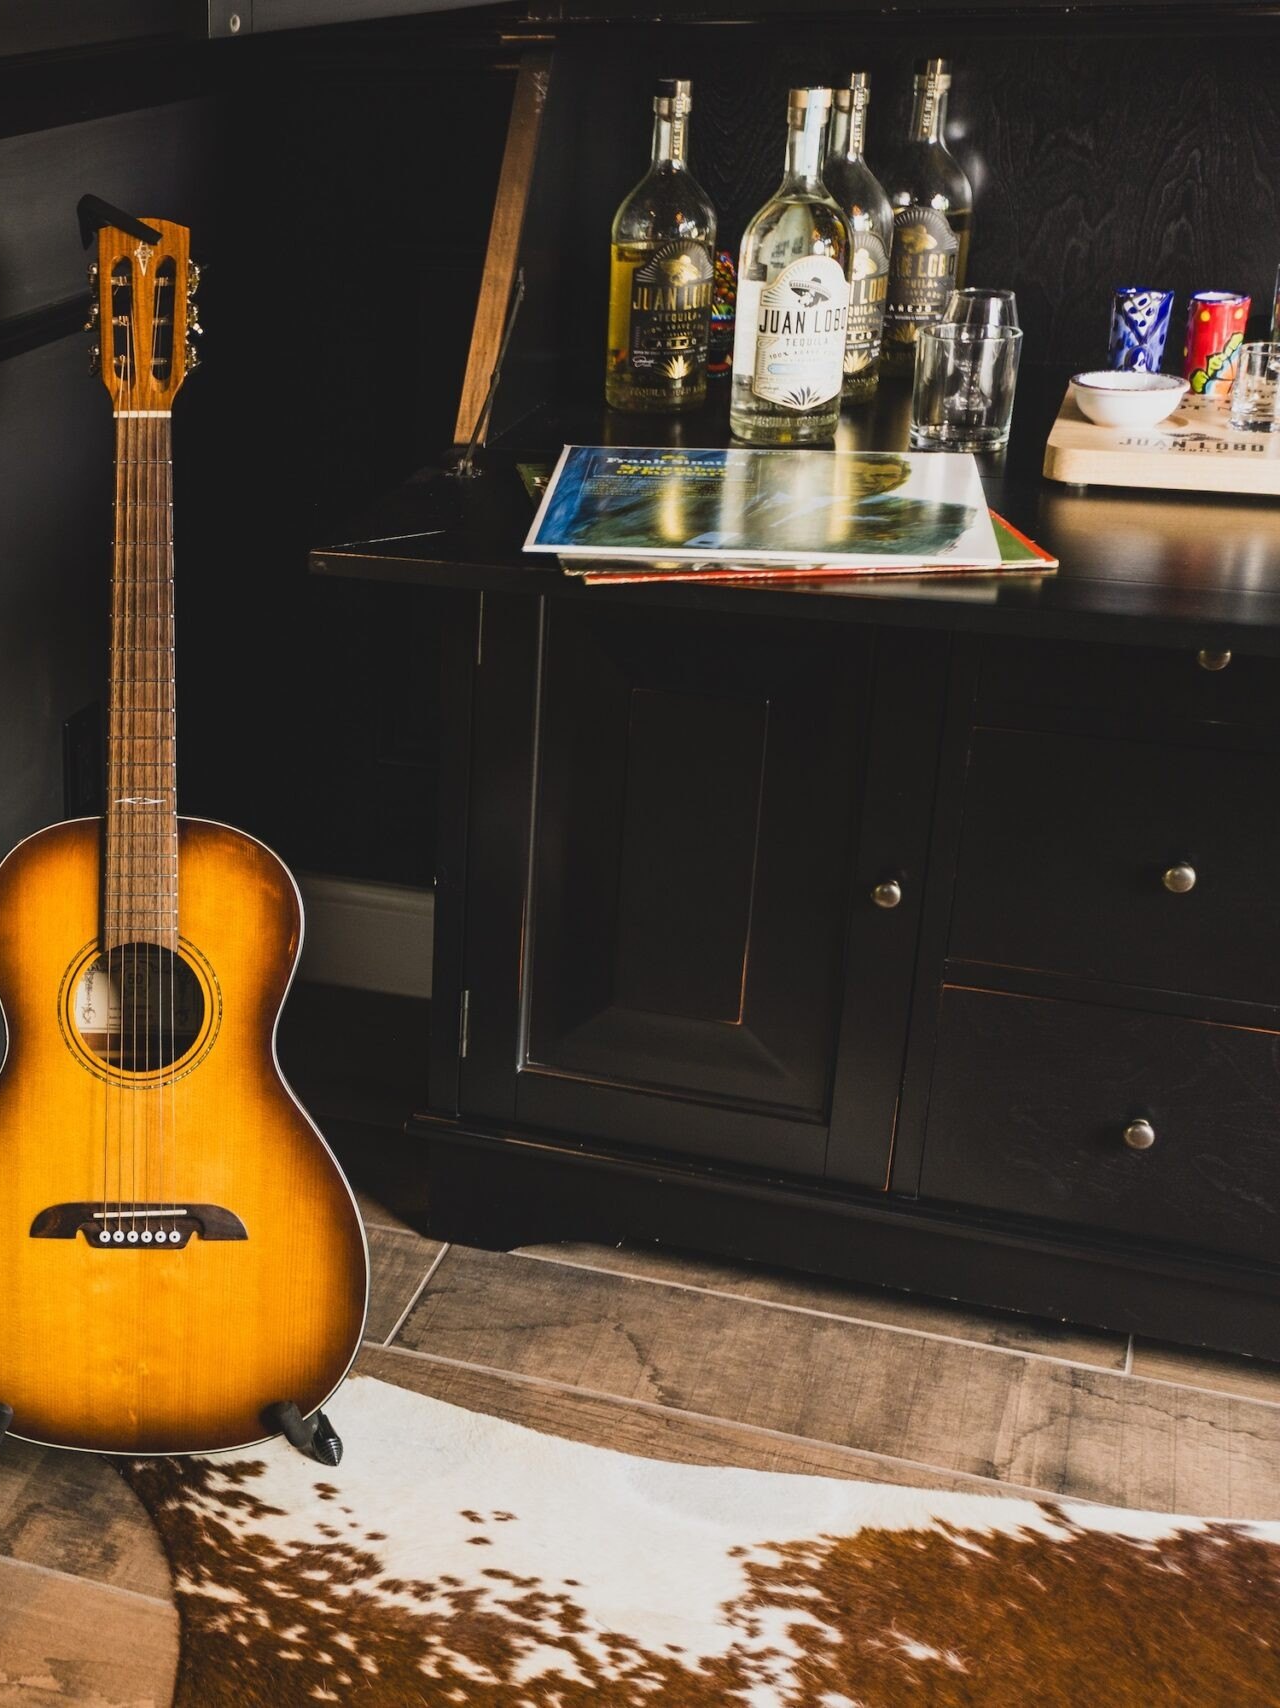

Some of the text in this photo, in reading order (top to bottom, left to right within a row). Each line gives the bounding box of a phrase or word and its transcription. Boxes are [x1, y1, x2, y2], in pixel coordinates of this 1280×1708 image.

[759, 305, 847, 335] JUAN LOBO
[785, 337, 829, 348] TEQUILA
[1119, 438, 1265, 453] JUAN LOBO
[606, 457, 666, 465] Frank
